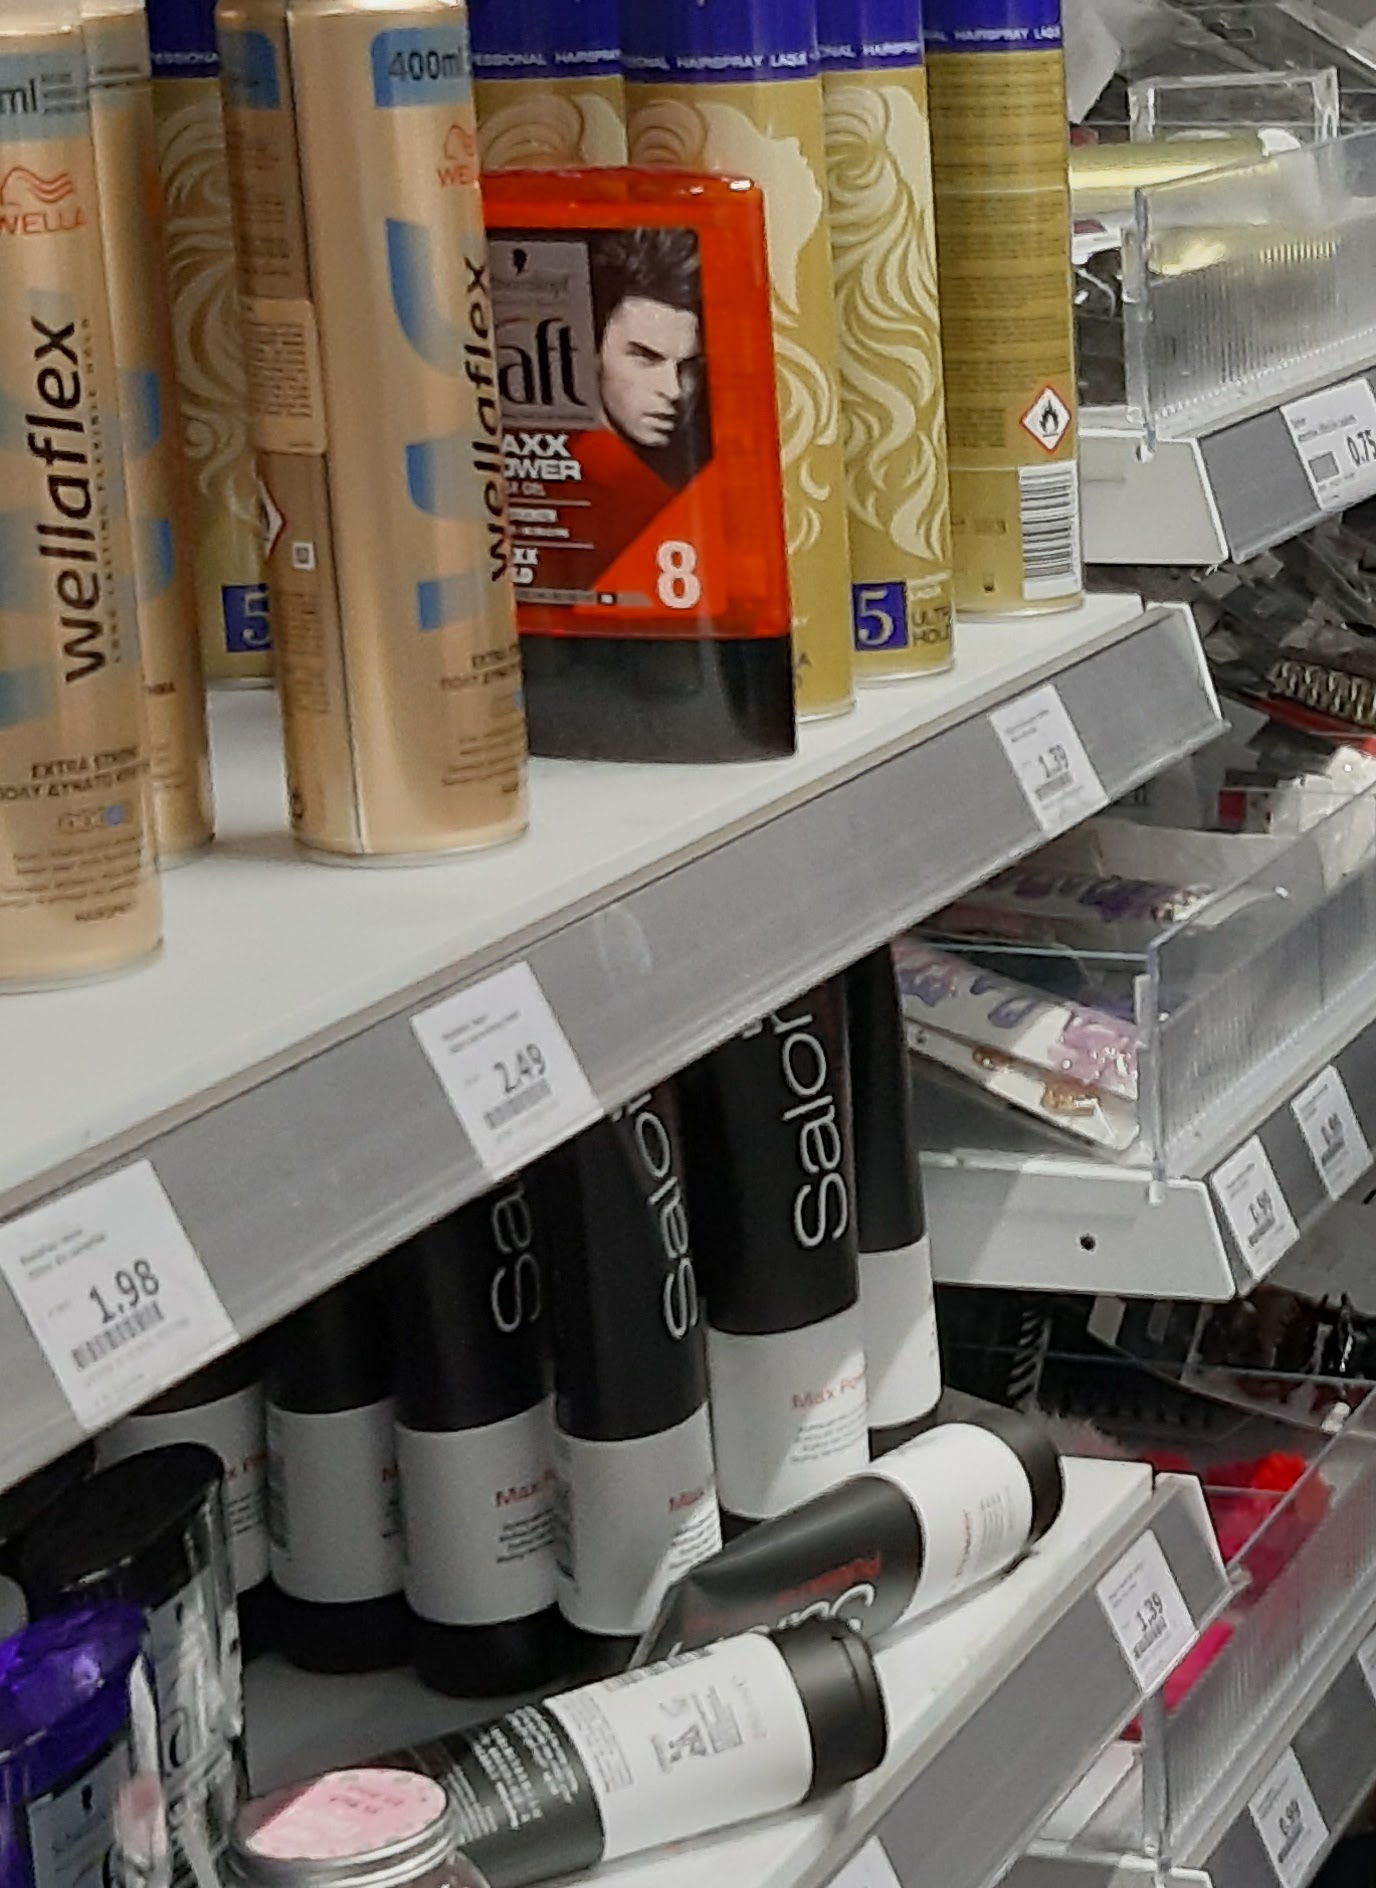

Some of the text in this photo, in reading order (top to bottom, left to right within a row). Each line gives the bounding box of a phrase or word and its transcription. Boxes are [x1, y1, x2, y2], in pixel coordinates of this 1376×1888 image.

[463, 257, 508, 584] wellaflex
[25, 315, 107, 685] wellaflex
[655, 539, 701, 610] 8
[856, 588, 895, 647] 5
[492, 1042, 546, 1093] 2.49
[89, 1257, 161, 1324] 1.98
[1135, 1590, 1165, 1635] 1.39
